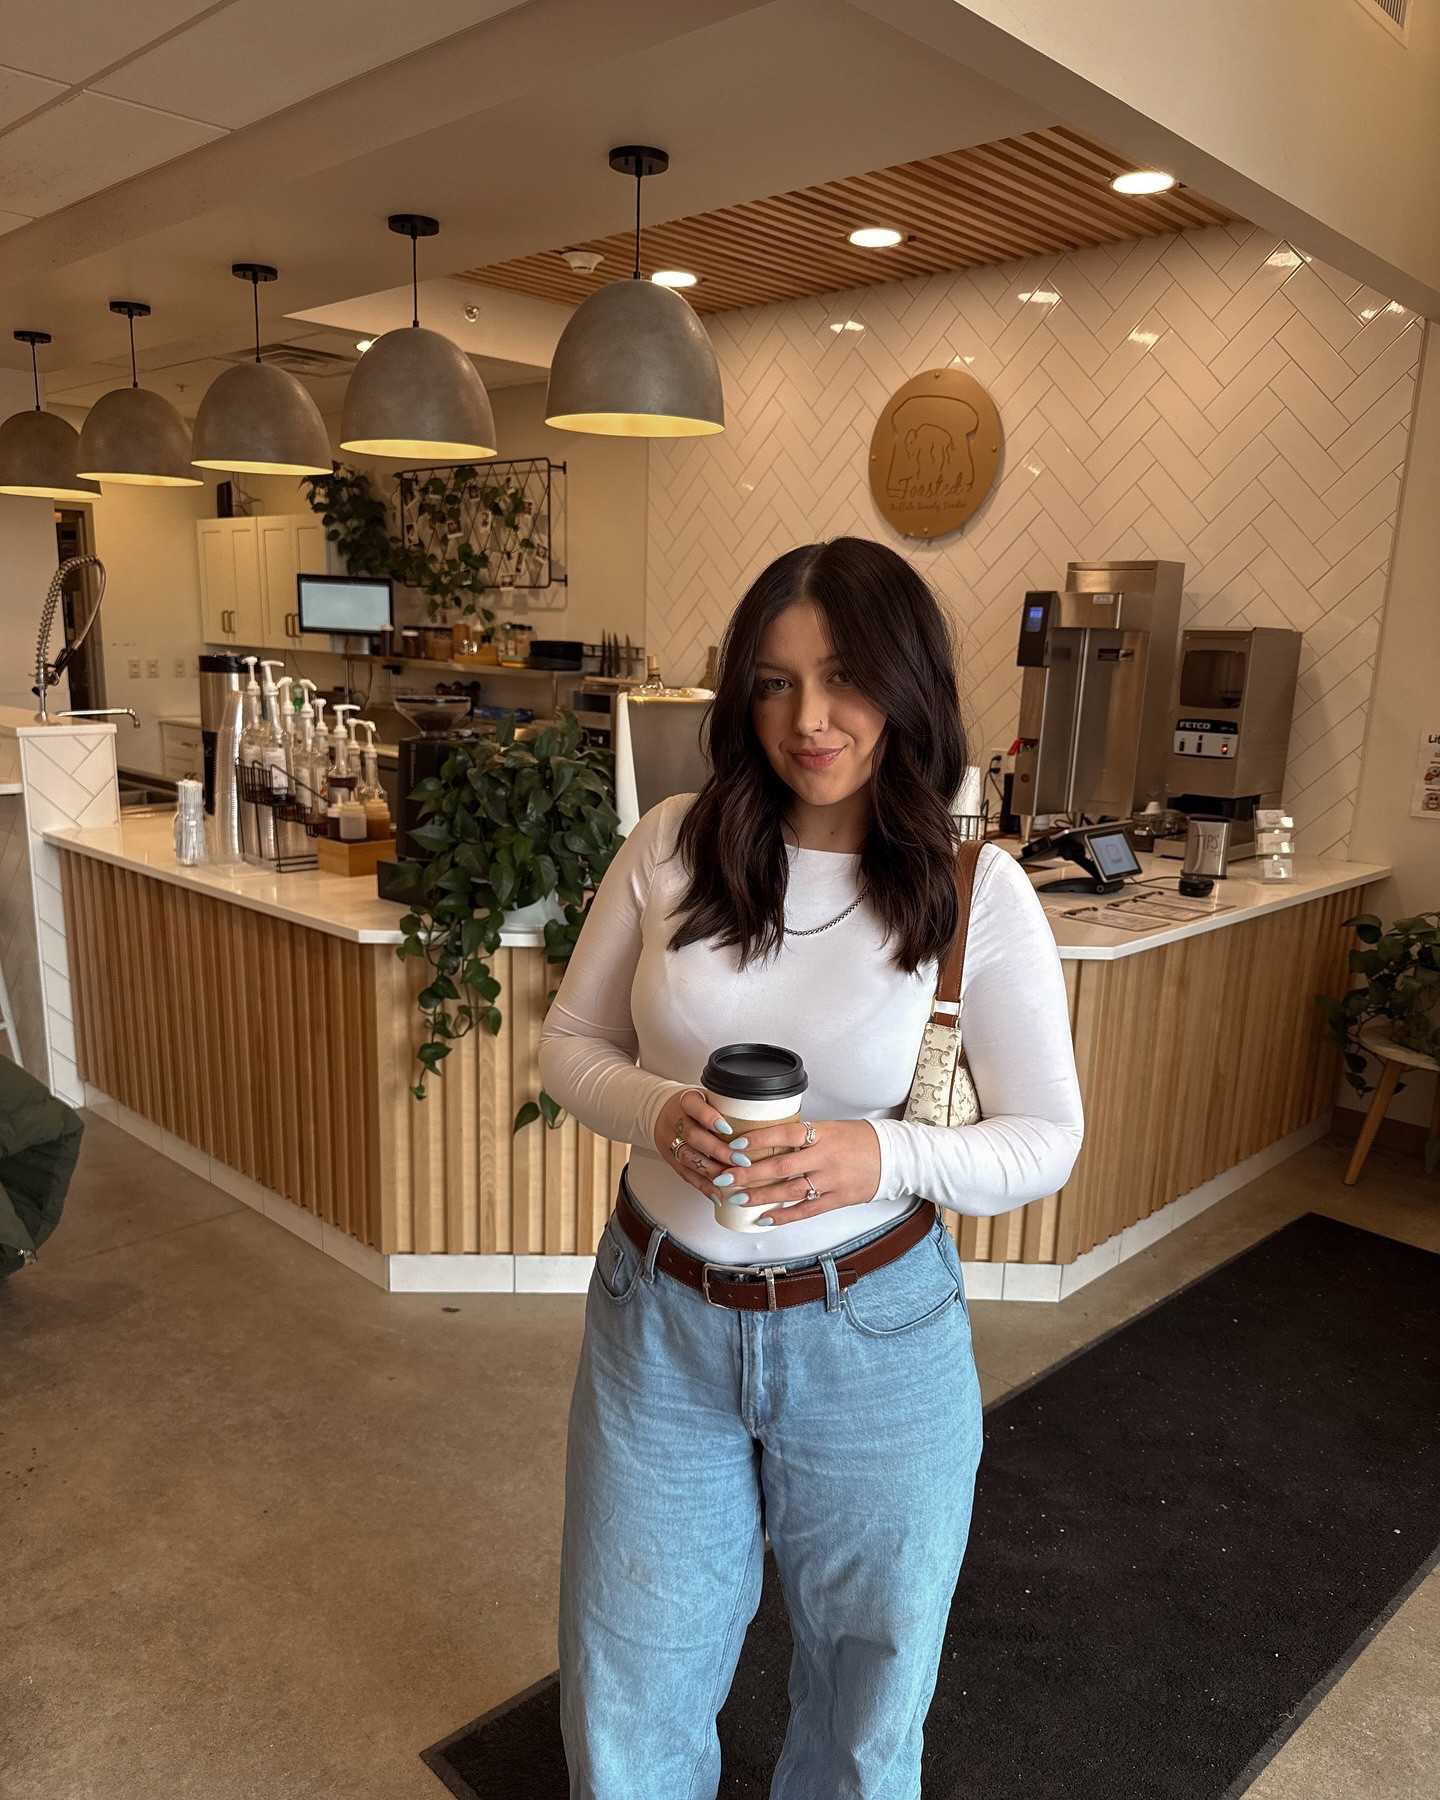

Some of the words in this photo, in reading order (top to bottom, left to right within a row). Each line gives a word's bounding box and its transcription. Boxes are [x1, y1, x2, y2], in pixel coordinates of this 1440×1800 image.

[898, 472, 964, 499] Toasted
[1179, 721, 1211, 730] FETCO
[1194, 834, 1219, 849] TIPS
